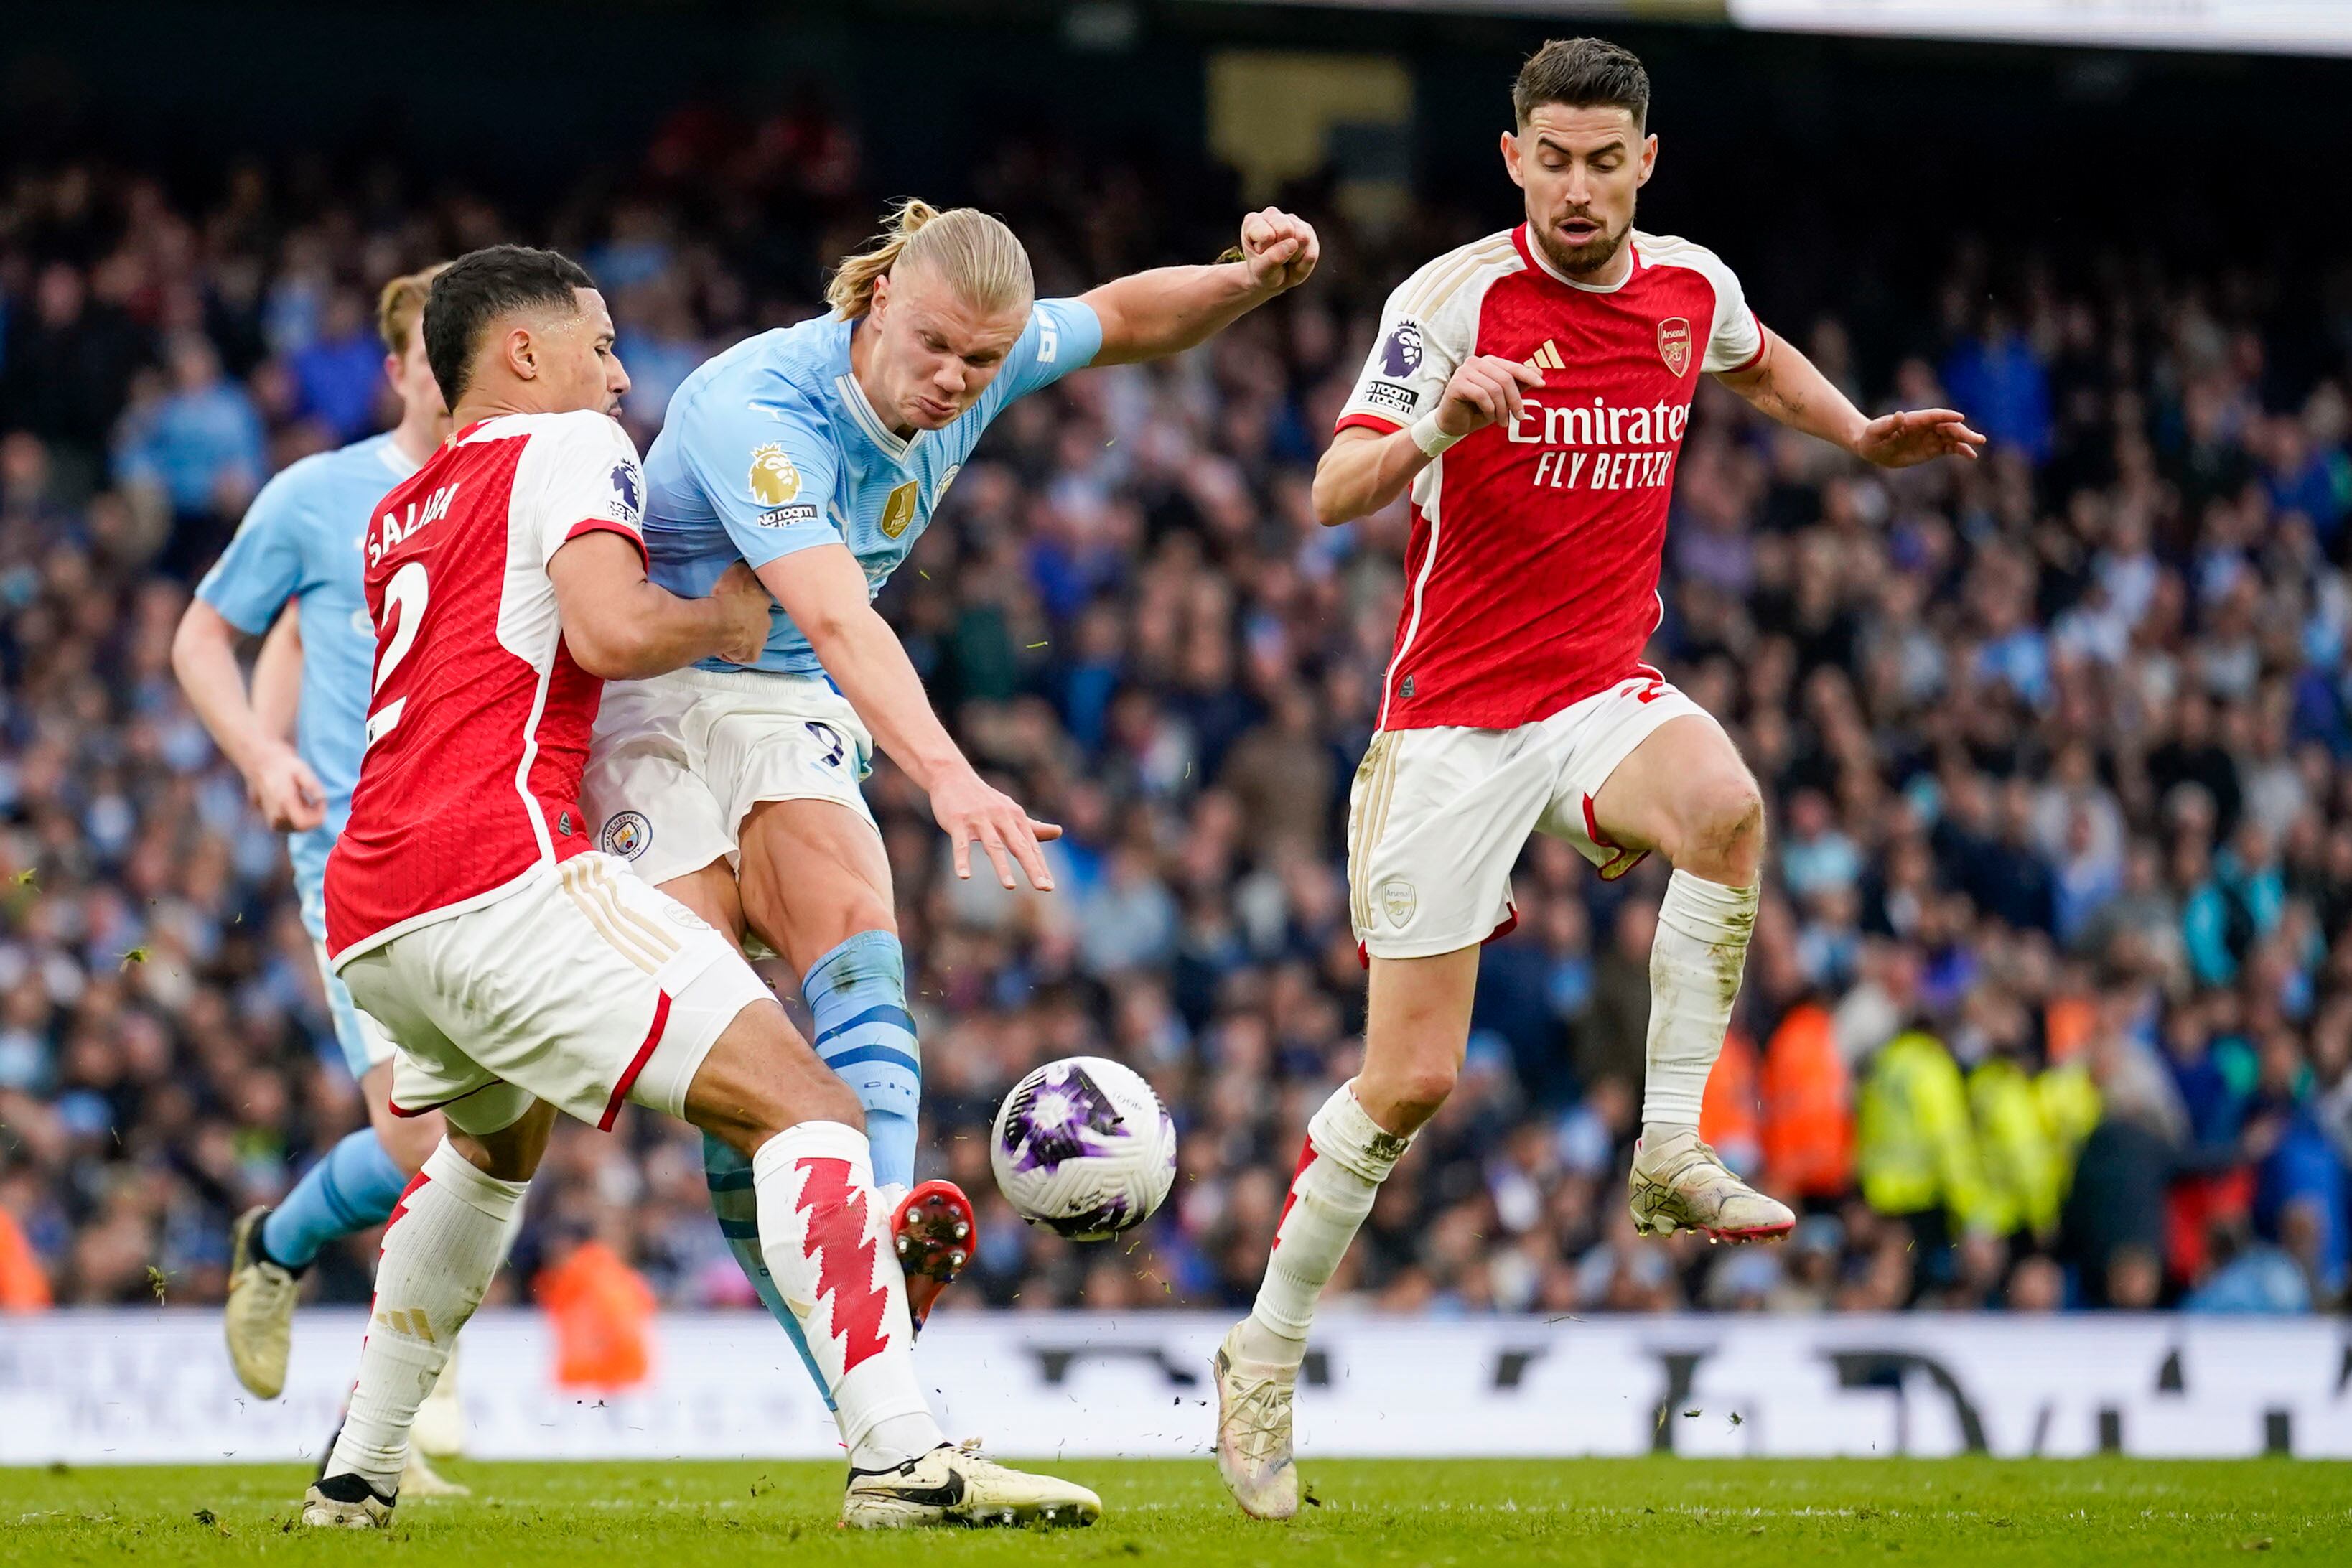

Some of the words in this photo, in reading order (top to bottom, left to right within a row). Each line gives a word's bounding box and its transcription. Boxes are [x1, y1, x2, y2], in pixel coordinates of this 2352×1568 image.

[1662, 327, 1686, 340] Arsenal
[1371, 392, 1414, 415] racism
[1376, 383, 1412, 403] room
[1533, 452, 1588, 489] FLY
[1590, 451, 1674, 490] BETTER
[368, 482, 459, 569] SALIBA
[757, 513, 776, 526] No
[777, 506, 813, 520] room
[606, 815, 640, 847] MANCHESTER
[627, 847, 642, 860] CITY
